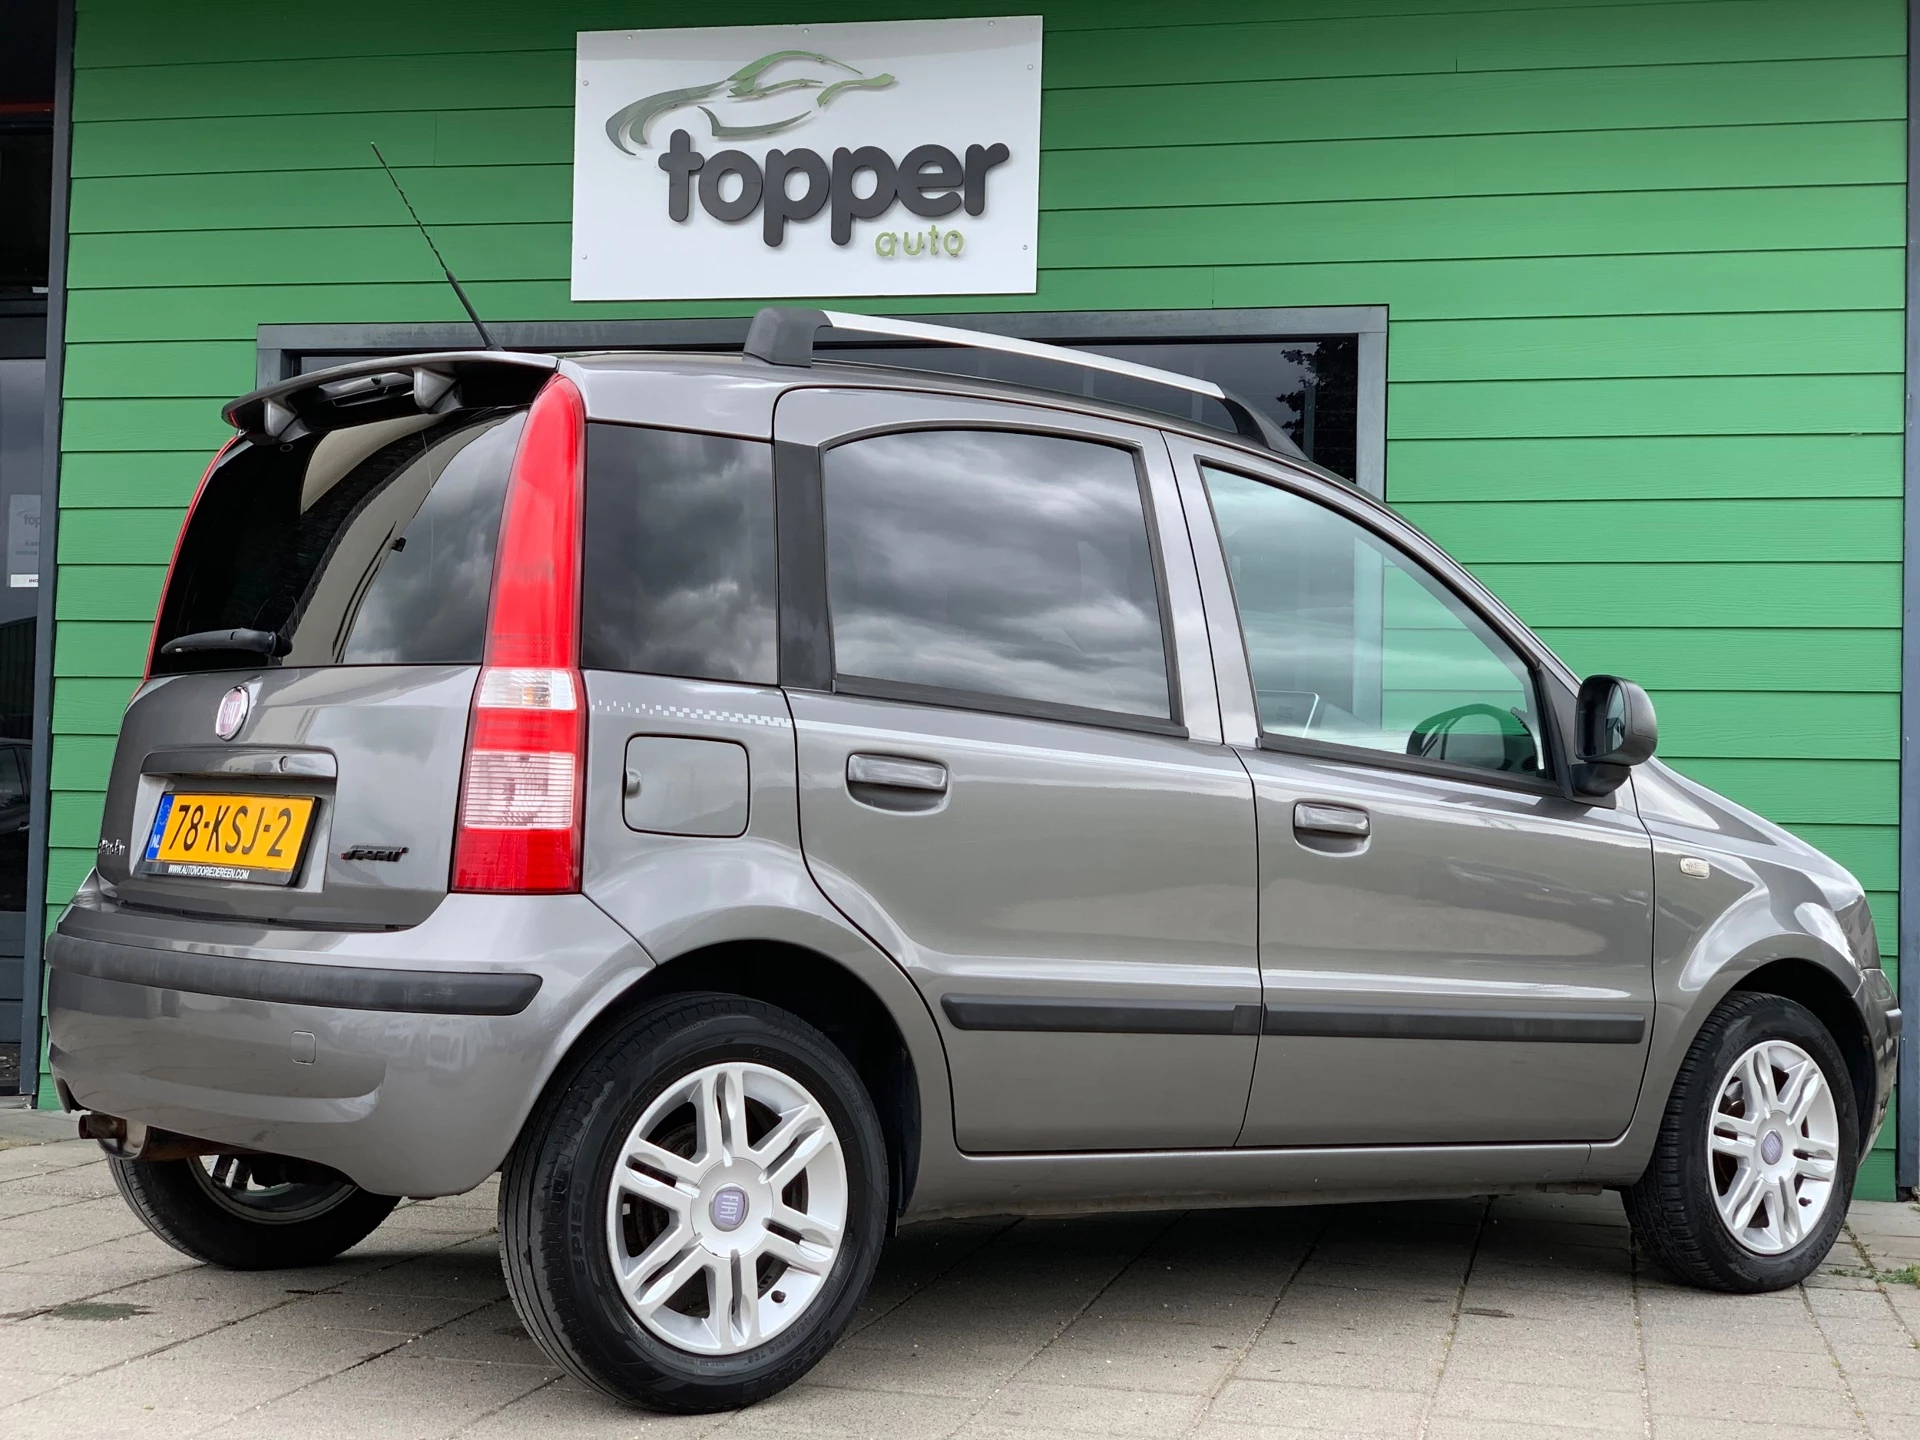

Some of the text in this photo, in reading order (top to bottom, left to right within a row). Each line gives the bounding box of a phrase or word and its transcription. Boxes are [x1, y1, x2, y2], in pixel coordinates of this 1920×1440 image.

[658, 128, 1010, 247] topper
[875, 225, 964, 257] auto
[151, 834, 161, 848] NL
[168, 804, 292, 858] 78-KSJ-2
[720, 1194, 739, 1223] FIAT
